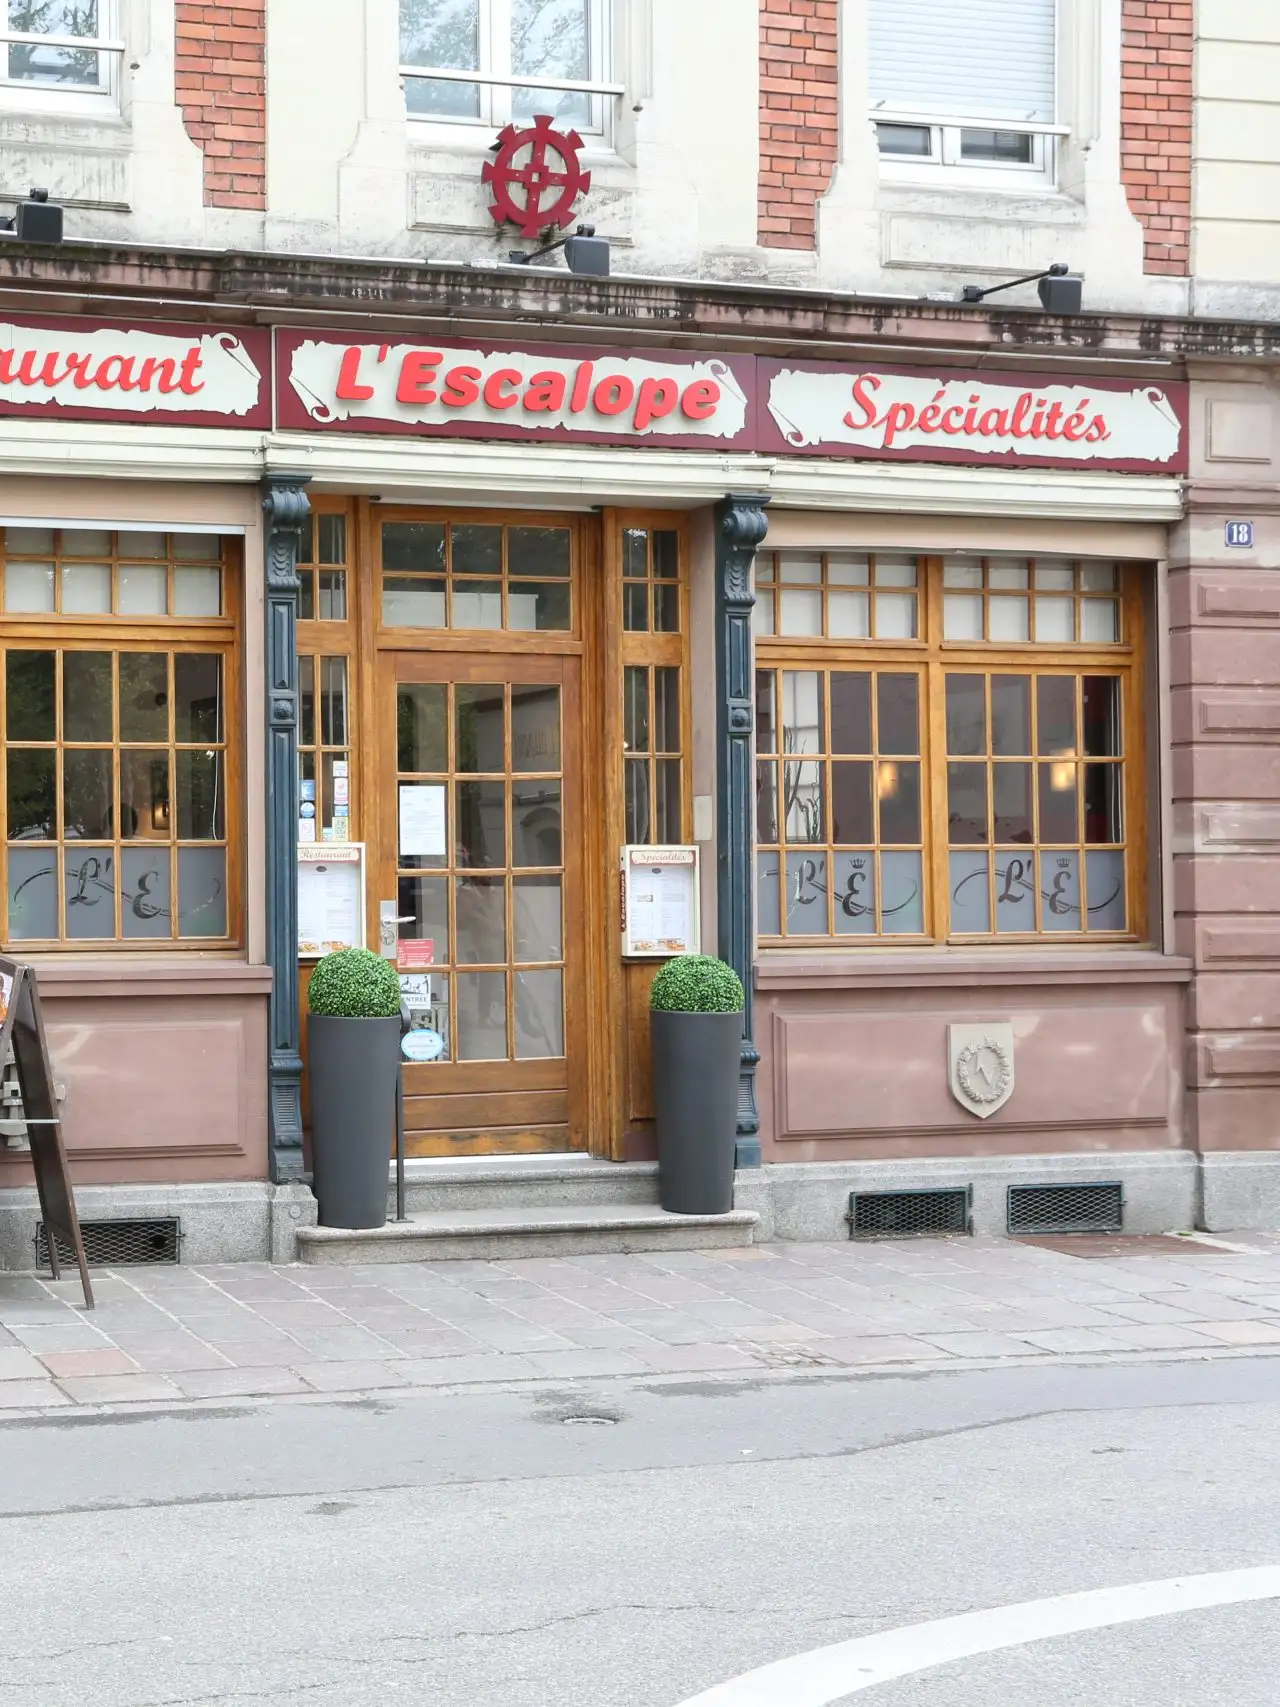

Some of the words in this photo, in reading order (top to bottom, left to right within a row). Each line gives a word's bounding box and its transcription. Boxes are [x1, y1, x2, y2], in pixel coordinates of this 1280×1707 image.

[335, 343, 722, 431] L'Escalope
[842, 372, 1112, 448] Spécialités
[1231, 523, 1249, 544] 18
[300, 849, 352, 860] Restaurant
